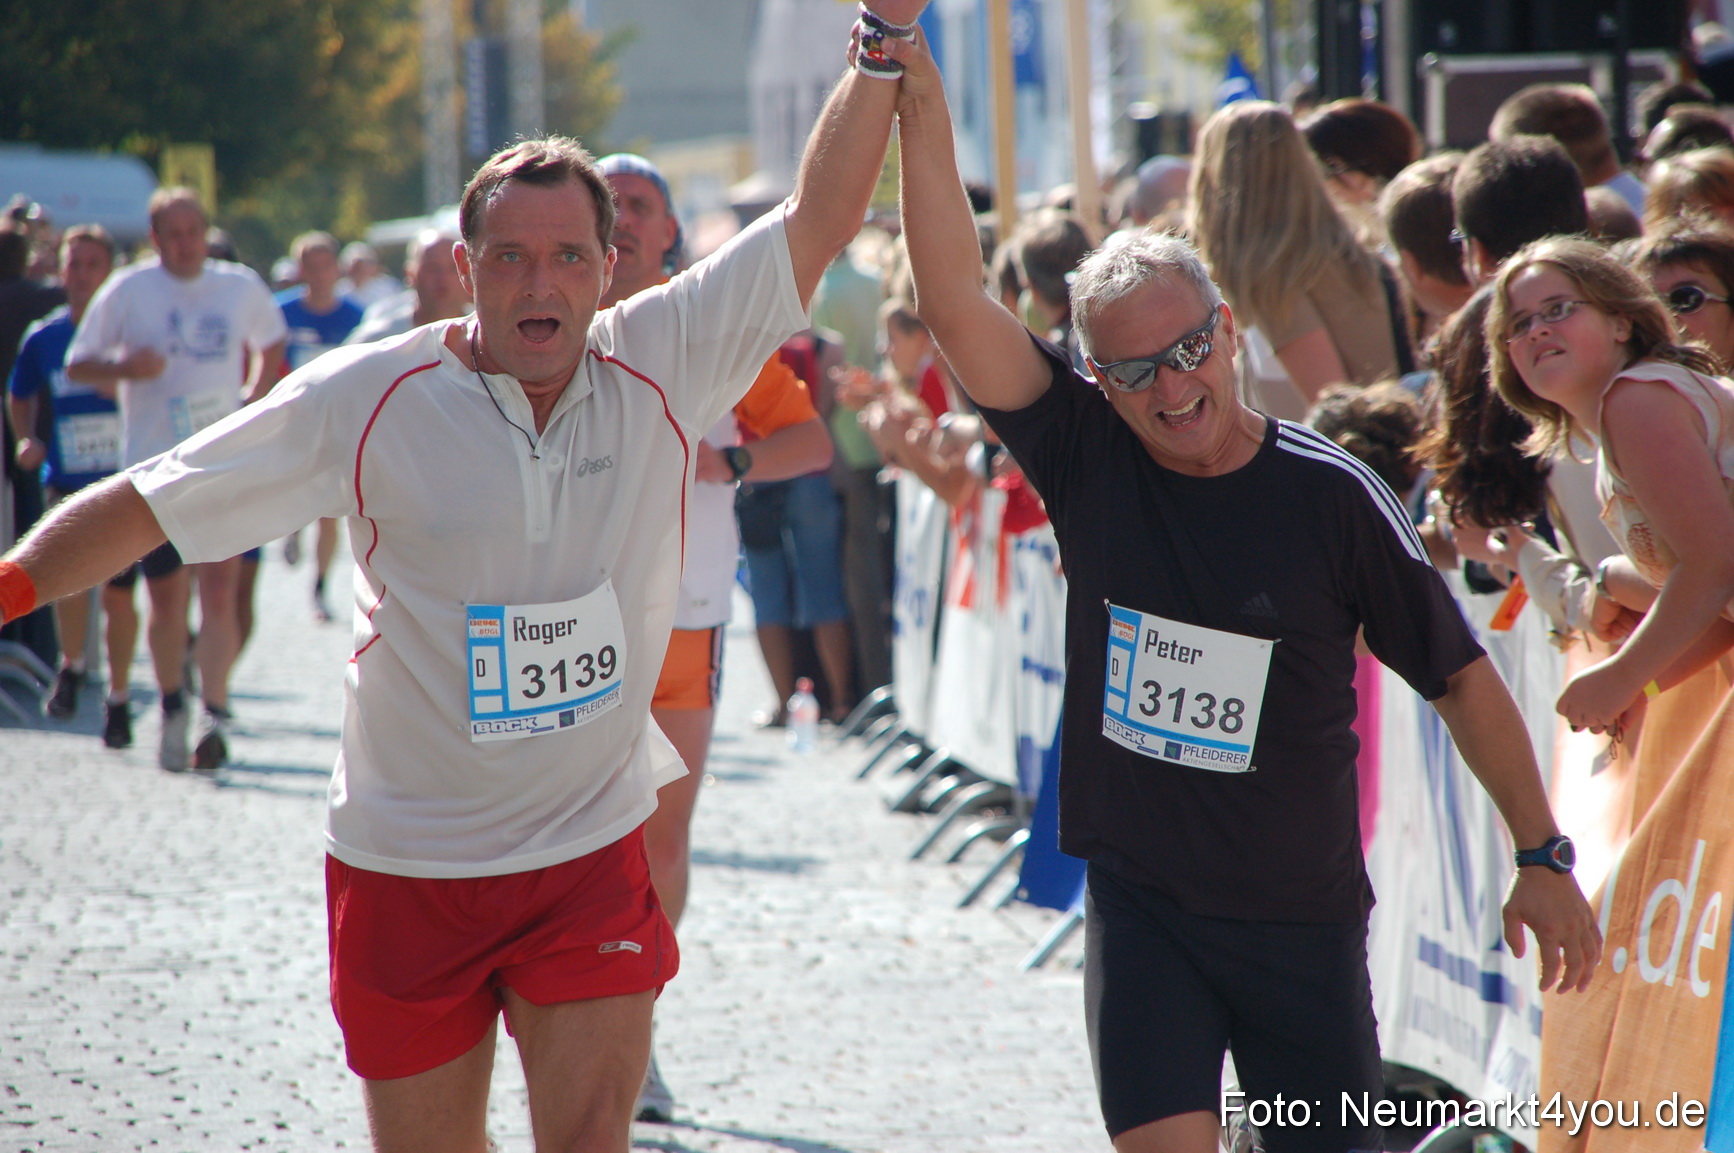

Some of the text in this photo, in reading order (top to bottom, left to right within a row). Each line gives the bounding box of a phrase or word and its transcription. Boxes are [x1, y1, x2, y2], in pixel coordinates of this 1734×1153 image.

[513, 616, 578, 645] Roger
[1144, 628, 1203, 665] Peter
[476, 658, 486, 678] D
[521, 645, 617, 699] 3139
[1111, 657, 1119, 677] D
[576, 687, 621, 718] PFLEIDERER
[1138, 679, 1246, 734] 3138
[473, 717, 538, 735] BOCK
[1104, 717, 1146, 745] BOCK
[1183, 744, 1248, 765] PFLEIDERER
